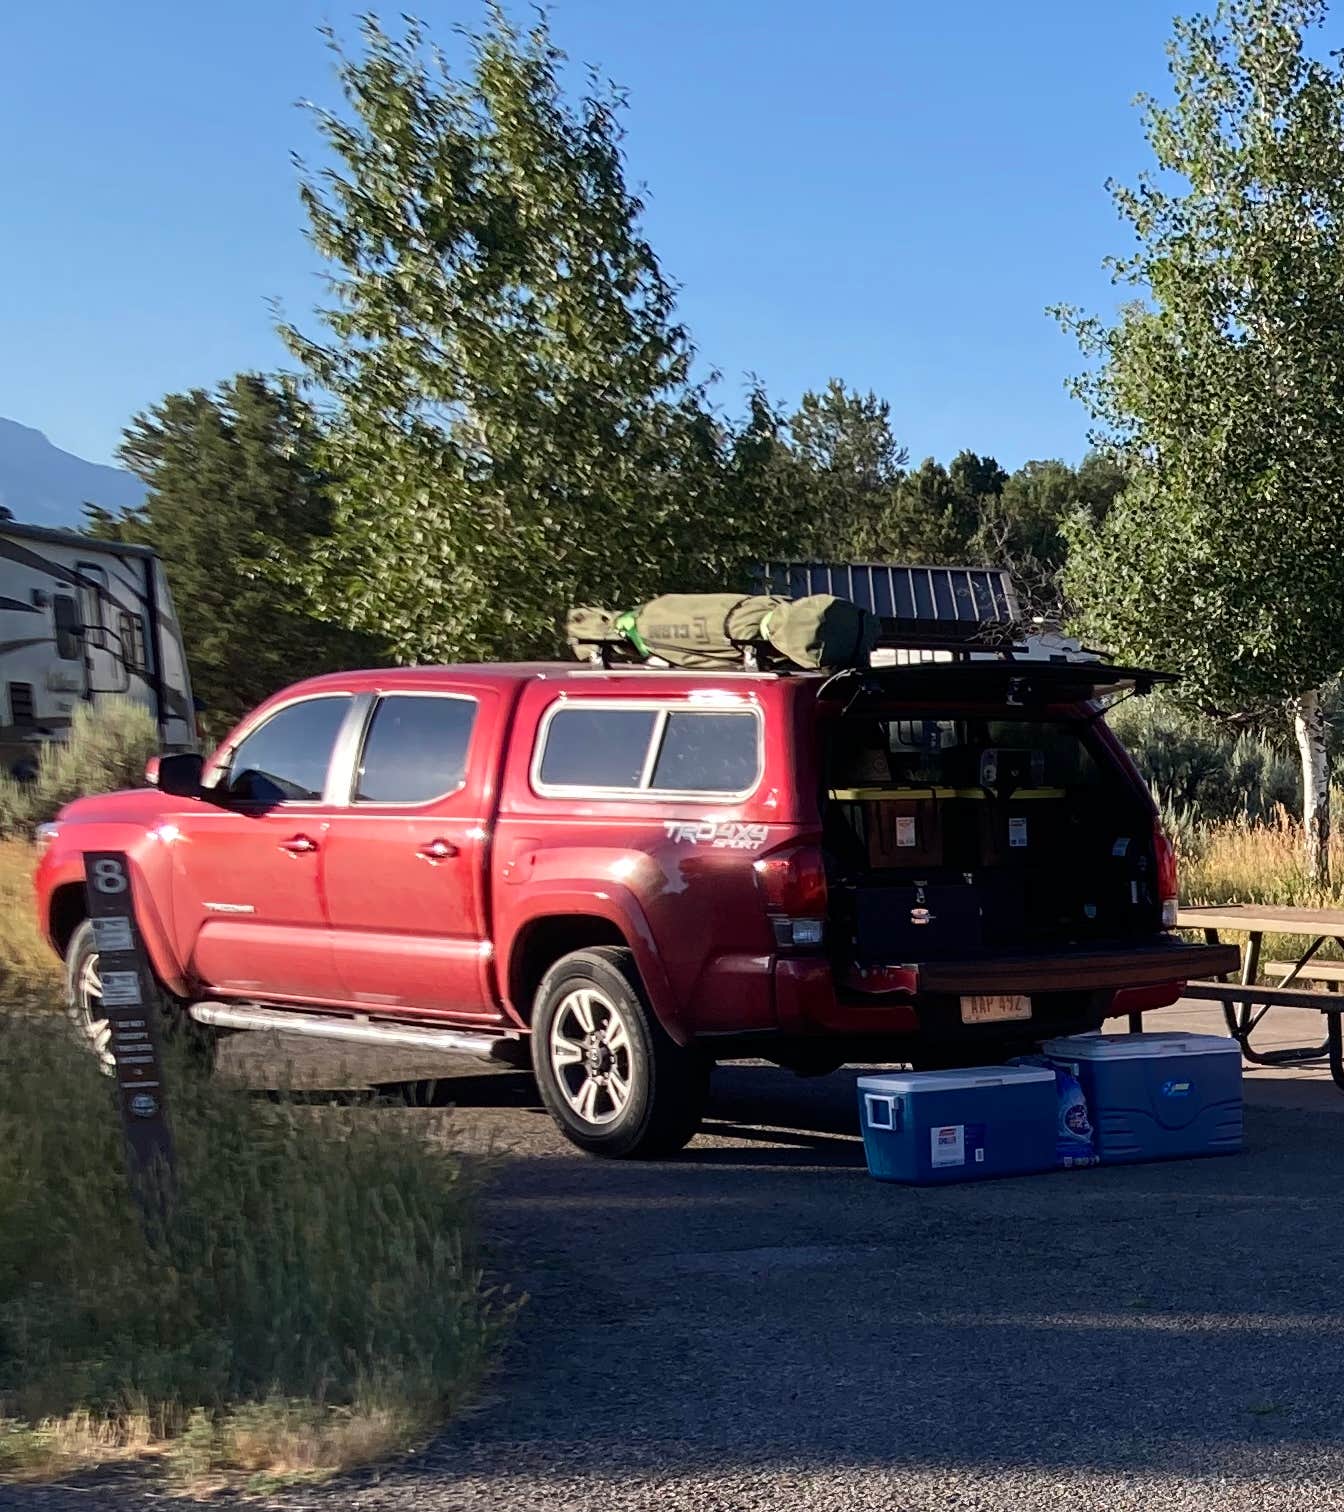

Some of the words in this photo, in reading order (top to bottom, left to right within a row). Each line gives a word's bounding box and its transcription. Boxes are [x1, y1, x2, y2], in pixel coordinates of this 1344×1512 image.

[664, 821, 717, 843] TRD
[712, 838, 763, 849] SPORT
[93, 859, 126, 893] 8
